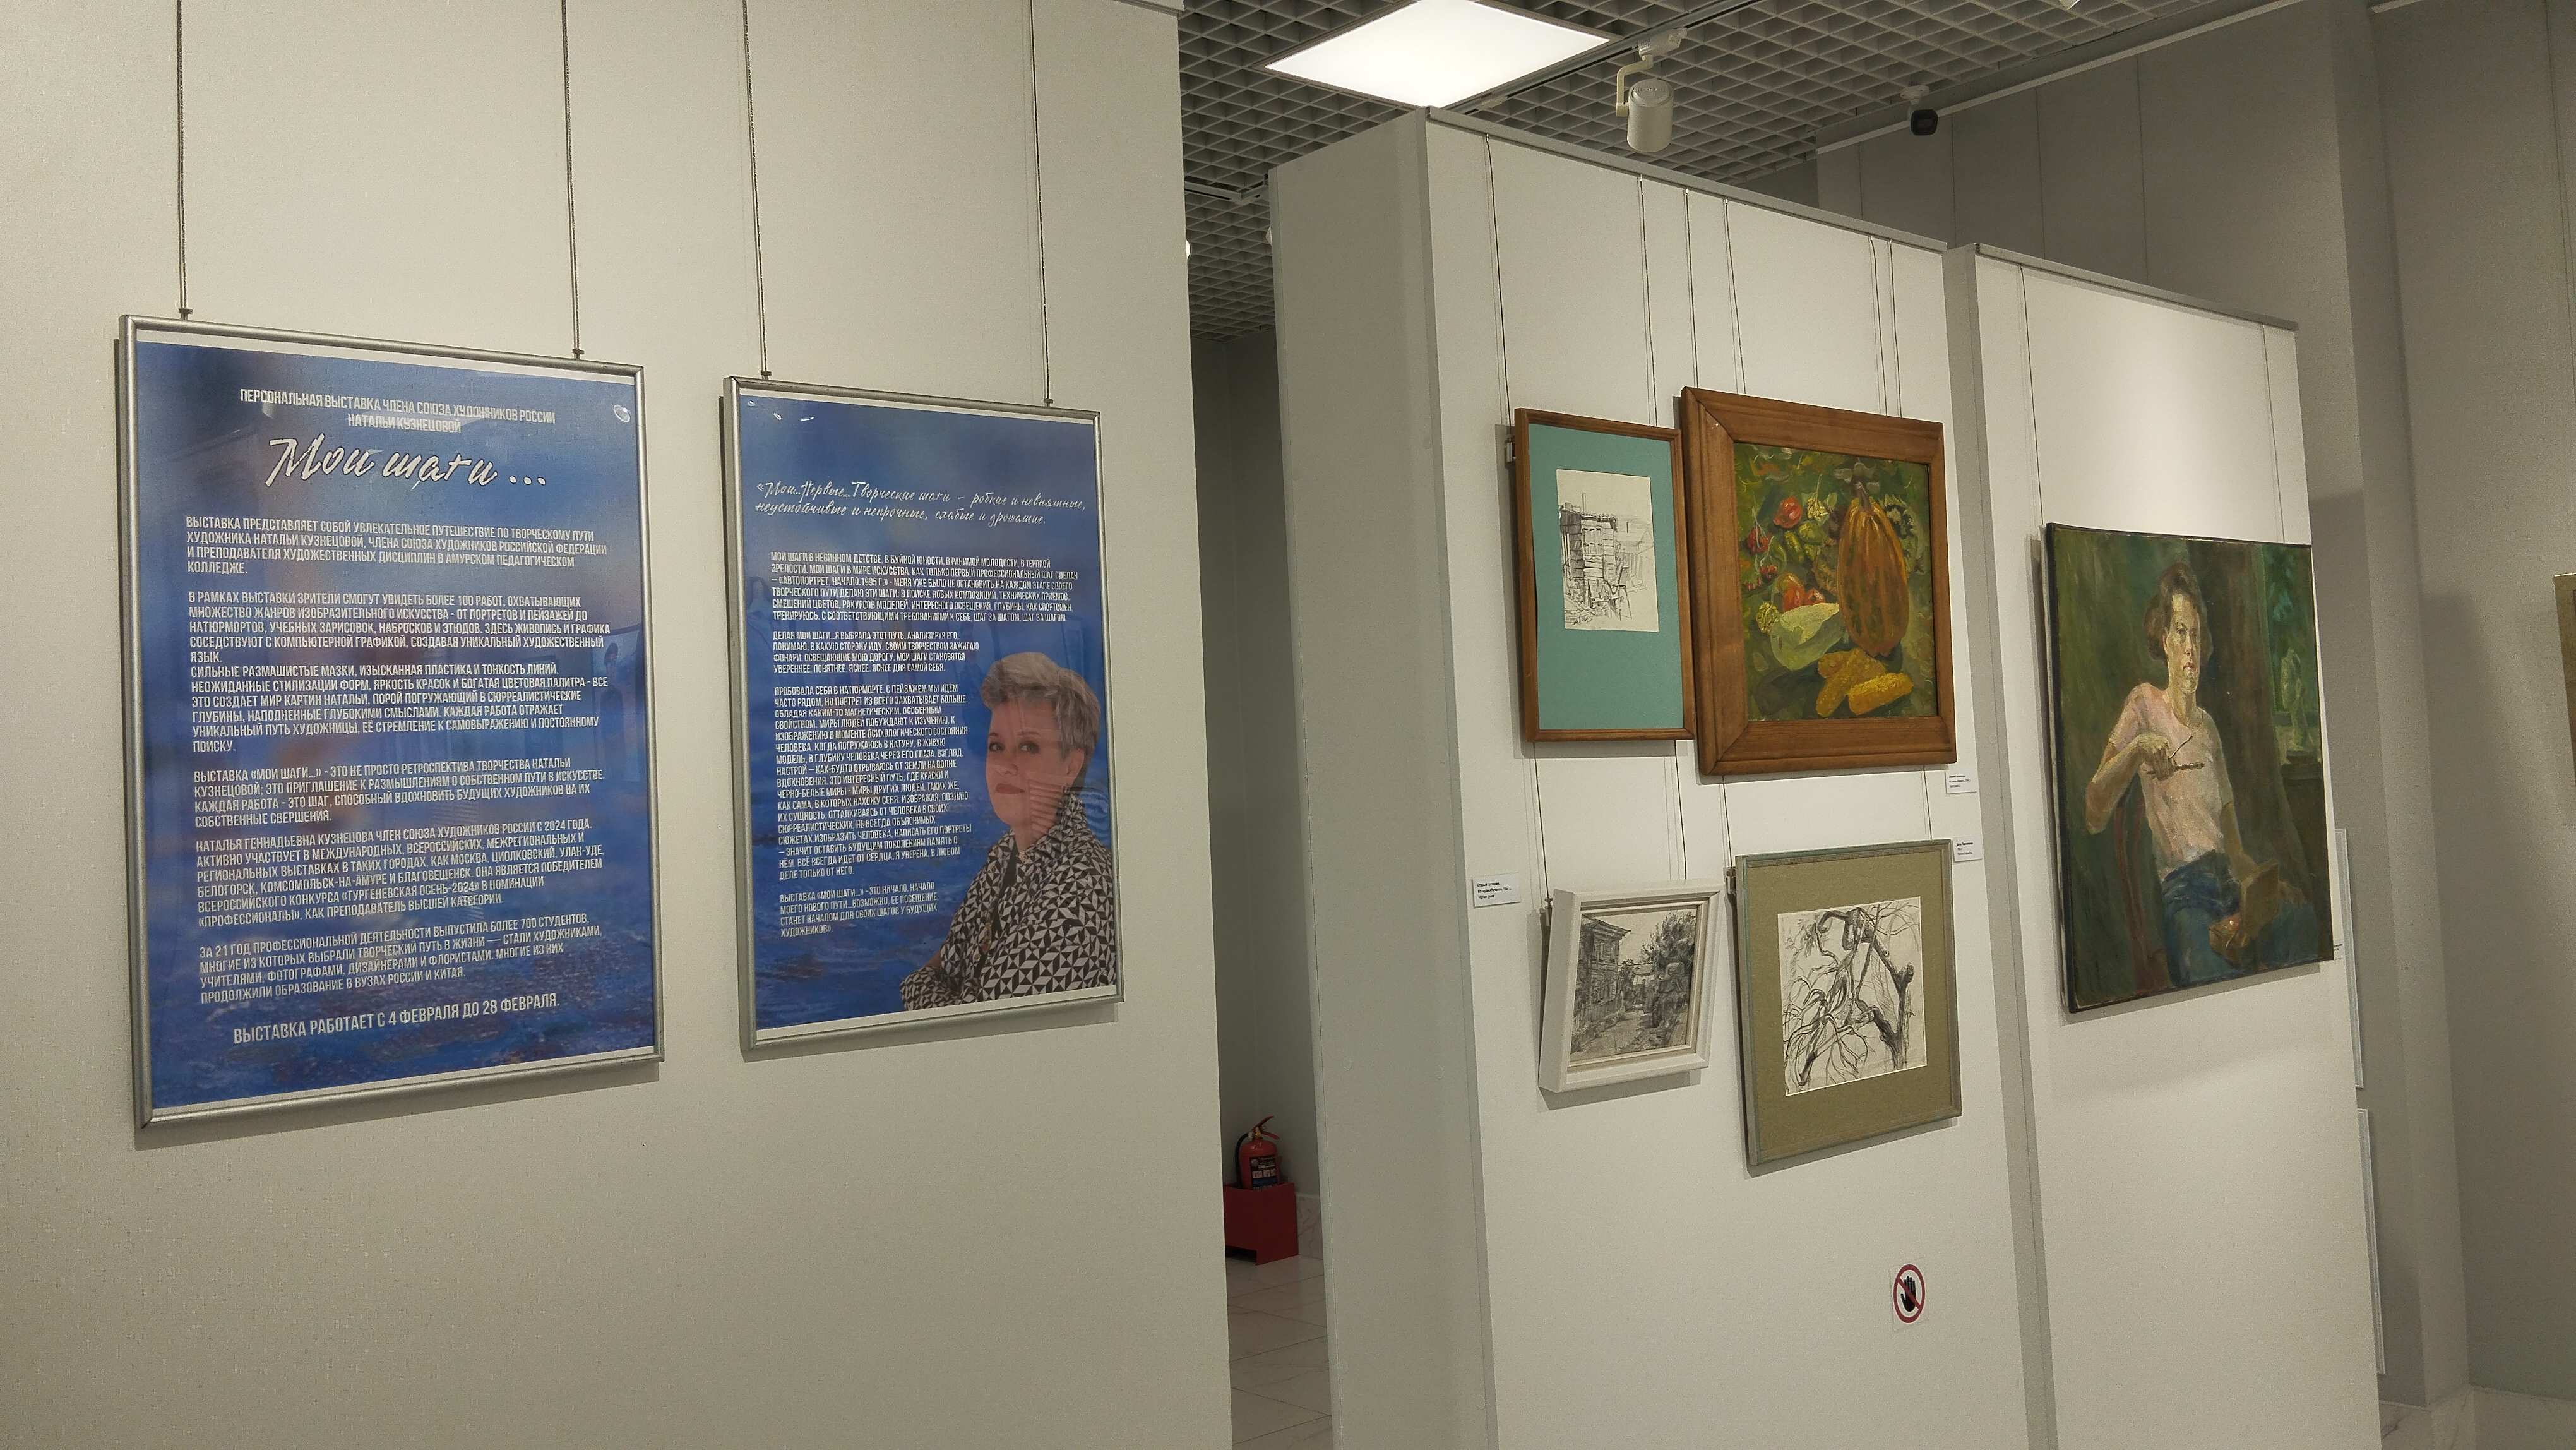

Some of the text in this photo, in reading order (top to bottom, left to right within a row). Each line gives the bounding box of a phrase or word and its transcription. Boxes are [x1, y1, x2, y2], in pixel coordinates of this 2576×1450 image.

[239, 386, 556, 424] ПЕРСОНАЛЬНАЯ ВЫСТАВКА ЧЛЕНА СОЮЗА ХУДОЖНИКОВ РОССИИ
[347, 412, 462, 435] НАТАЛЬИ КУЗНЕЦОВОЙ
[264, 432, 375, 488] Мои
[382, 452, 498, 486] шаги
[756, 500, 847, 517] неустойчивые
[851, 506, 861, 516] и
[863, 506, 928, 522] непрочные,
[934, 508, 975, 521] слабые
[979, 511, 987, 522] и
[919, 492, 952, 502] шаги
[970, 491, 1008, 508] робкие
[1011, 496, 1019, 505] и
[1021, 493, 1086, 512] невнятные,
[186, 515, 594, 541] ВЫСТАВКА ПРЕДСТАВЛЯЕТ СОБОЙ УВЛЕКАТЕЛЬНОЕ ПУТЕШЕСТВИЕ ПО ТВОРЧЕСКОМУ ПУТИ
[186, 530, 252, 546] ХУДОЖНИКА
[253, 532, 299, 546] НАТАЛЬИ
[367, 536, 399, 549] ЧЛЕНА
[401, 537, 433, 550] СОЮЗА
[435, 538, 498, 553] ХУДОЖНИКОВ
[498, 538, 554, 553] РОССИЙСКОЙ
[555, 542, 607, 556] ФЕДЕРАЦИИ
[186, 545, 575, 568] И ПРЕПОДАВАТЕЛЯ ХУДОЖЕСТВЕННЫХ ДИСЦИПЛИН В АМУРСКОМ ПЕДАГОГИЧЕСКОМ
[770, 551, 787, 561] МОИ
[787, 551, 808, 561] ШАГИ
[808, 552, 814, 562] В
[814, 552, 852, 563] НЕВИННОМ
[884, 554, 890, 563] В
[890, 552, 916, 564] БУЙНОЙ
[945, 555, 950, 565] В
[950, 553, 980, 566] РАНИМОЙ
[1020, 557, 1025, 566] В
[1025, 556, 1051, 567] ТЕРПКОЙ
[188, 590, 196, 602] В
[197, 590, 239, 603] РАМКАХ
[241, 591, 295, 604] ВЫСТАВКИ
[297, 592, 341, 604] ЗРИТЕЛИ
[342, 592, 380, 605] СМОГУТ
[381, 593, 424, 606] УВИДЕТЬ
[425, 594, 455, 606] БОЛЕЕ
[457, 594, 474, 606] 100
[507, 595, 581, 608] ОХВАТЫВАЮЩИХ
[269, 621, 317, 633] УЧЕБНЫХ
[378, 621, 432, 633] НАБРОСКОВ
[434, 622, 441, 633] И
[484, 622, 513, 635] ЗДЕСЬ
[514, 622, 562, 633] ЖИВОПИСЬ
[563, 623, 569, 633] И
[570, 623, 611, 634] ГРАФИКА
[809, 641, 815, 651] В
[815, 641, 838, 651] КАКУЮ
[839, 641, 868, 650] СТОРОНУ
[885, 640, 907, 650] СВОИМ
[907, 640, 948, 650] ТВОРЧЕСТВОМ
[949, 640, 979, 650] ЗАЖИГАЮ
[190, 665, 240, 678] СИЛЬНЫЕ
[242, 664, 319, 678] РАЗМАШИСТЫЕ
[359, 664, 423, 676] ИЗЫСКАННАЯ
[424, 663, 472, 675] ПЛАСТИКА
[473, 663, 480, 675] И
[481, 663, 526, 674] ТОНКОСТЬ
[774, 697, 796, 708] ЧАСТО
[824, 697, 834, 707] НО
[834, 696, 862, 706] ПОРТРЕТ
[863, 695, 873, 705] ИЗ
[873, 695, 893, 705] ВСЕГО
[894, 694, 939, 705] ЗАХВАТЫВАЕТ
[195, 837, 242, 854] НАТАЛЬЯ
[244, 833, 316, 852] ГЕННАДЬЕВНА
[317, 830, 374, 847] КУЗНЕЦОВА
[375, 828, 401, 842] ЧЛЕН
[402, 826, 436, 841] СОЮЗА
[437, 822, 500, 839] ХУДОЖНИКОВ
[501, 820, 535, 834] РОССИИ
[537, 820, 543, 832] С
[544, 818, 566, 831] 2024
[778, 869, 798, 882] ДЕЛЕ
[799, 866, 825, 879] ТОЛЬКО
[825, 866, 835, 877] ОТ
[780, 901, 938, 927] СТАНЕТ НАЧАЛОМ ДЛЯ СВОИХ ШАГОВ У БУДУЩИХ
[199, 945, 213, 960] ЗА
[215, 944, 227, 959] 21
[230, 942, 251, 959] ГОД
[253, 930, 357, 955] ПРОФЕССИОНАЛЬНОЙ
[359, 925, 431, 946] ДЕЯТЕЛЬНОСТИ
[432, 920, 489, 938] ВЫПУСТИЛА
[489, 917, 518, 932] БОЛЕЕ
[520, 916, 537, 929] 700
[200, 985, 273, 1007] ПРОДОЛЖИЛИ
[275, 978, 344, 997] ОБРАЗОВАНИЕ
[345, 976, 352, 990] В
[354, 973, 386, 988] ВУЗАХ
[387, 969, 424, 985] РОССИИ
[425, 968, 432, 981] И
[233, 1020, 307, 1046] ВЫСТАВКА
[309, 1012, 374, 1036] РАБОТАЕТ
[377, 1011, 385, 1028] С
[388, 1010, 397, 1027] 4
[399, 1002, 459, 1026] ФЕВРАЛЯ
[462, 1000, 480, 1019] ДО
[482, 998, 498, 1016] 28
